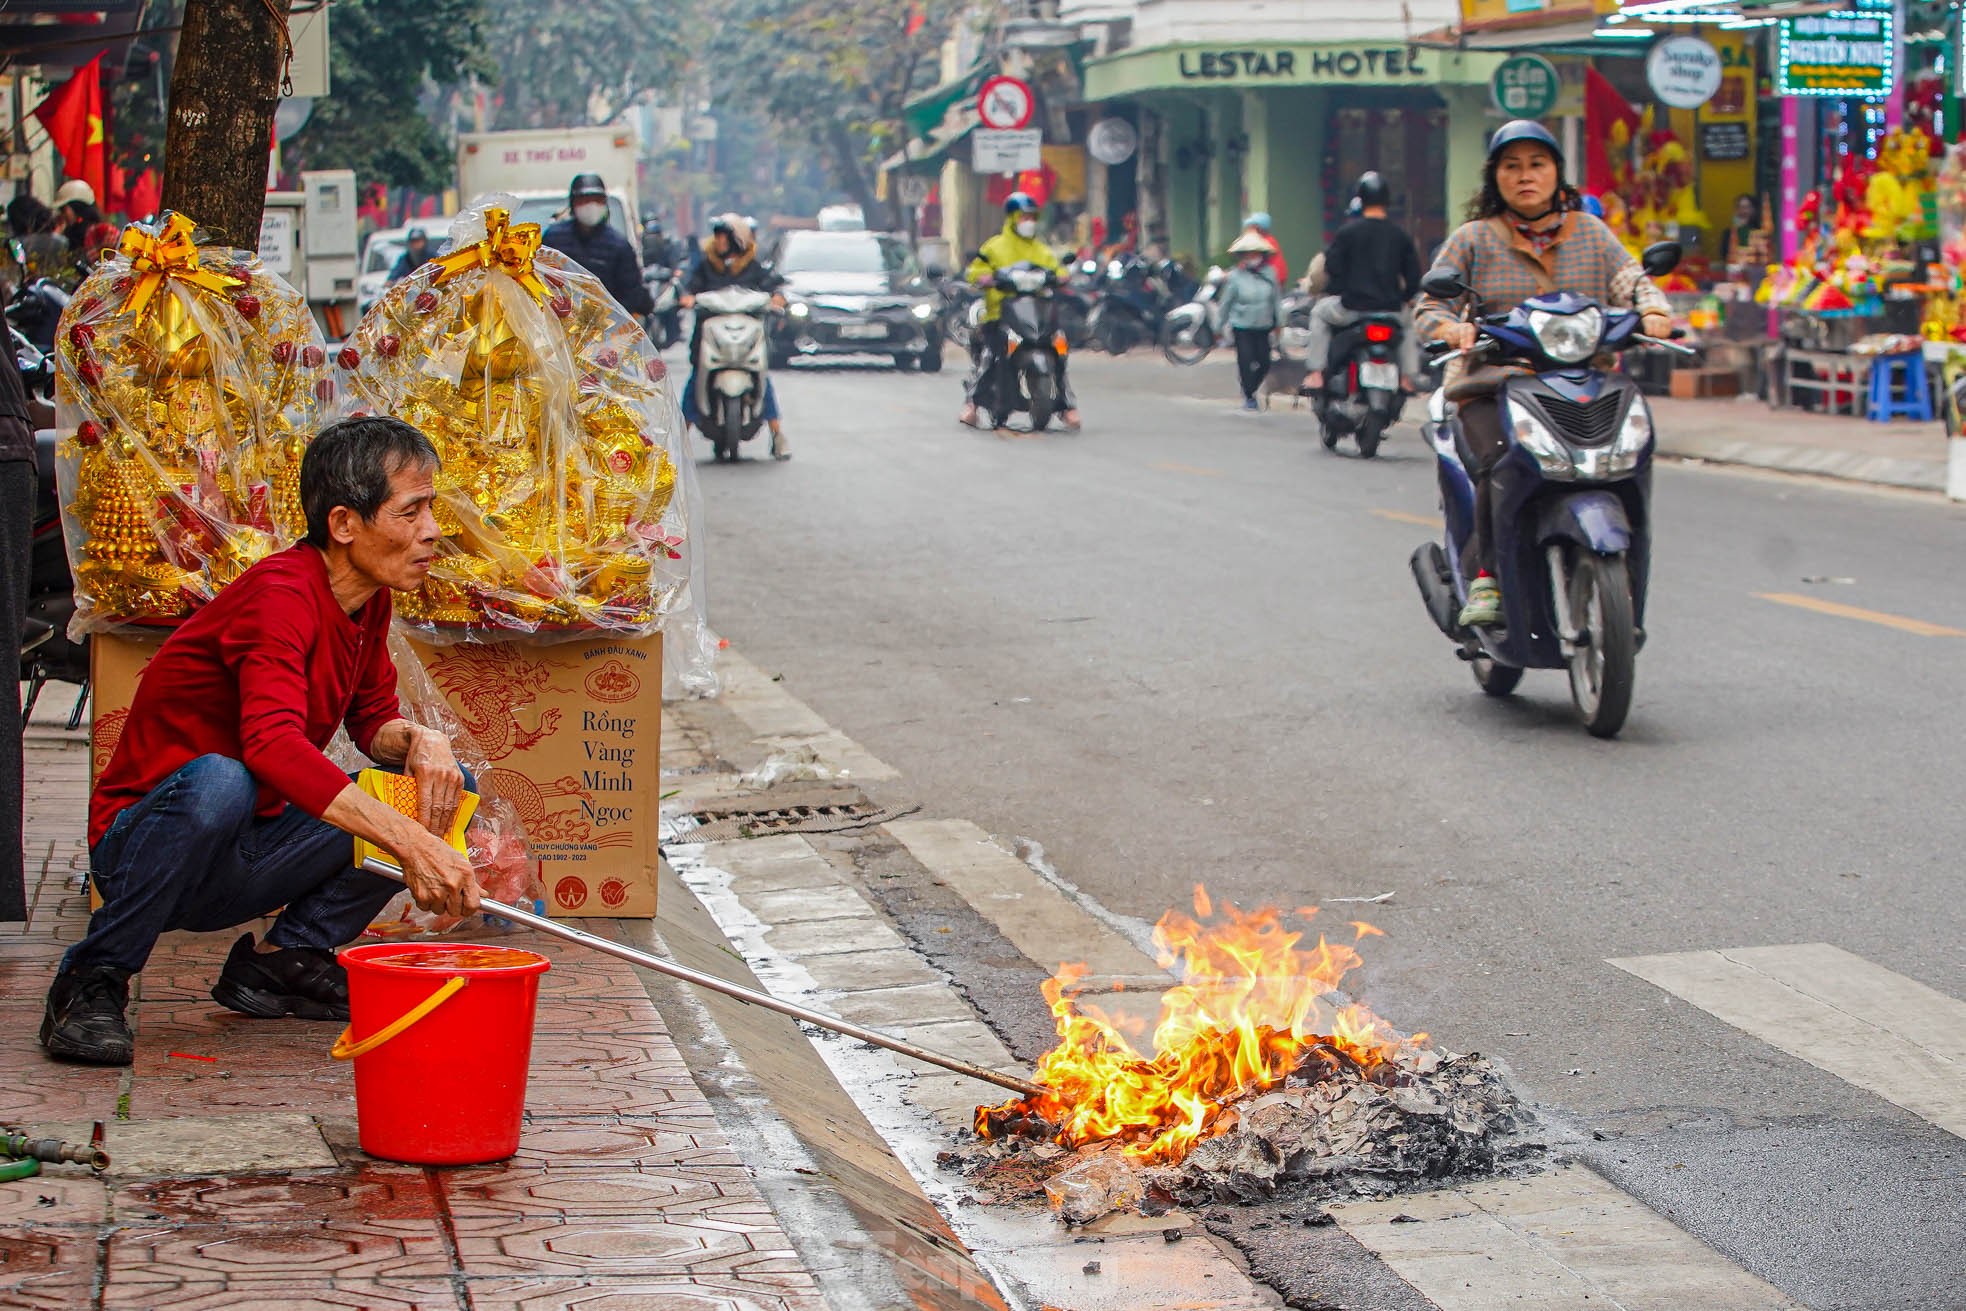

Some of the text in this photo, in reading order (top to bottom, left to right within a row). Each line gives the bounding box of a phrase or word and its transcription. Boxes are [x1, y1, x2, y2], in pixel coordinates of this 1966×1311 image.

[1179, 49, 1425, 78] LESTAR HOTEL
[584, 646, 606, 660] BÁNH
[625, 647, 648, 661] XANH
[582, 710, 636, 739] Rồng
[583, 741, 635, 768] Vàng
[582, 770, 633, 791] Minh
[580, 800, 633, 827] Ngọc
